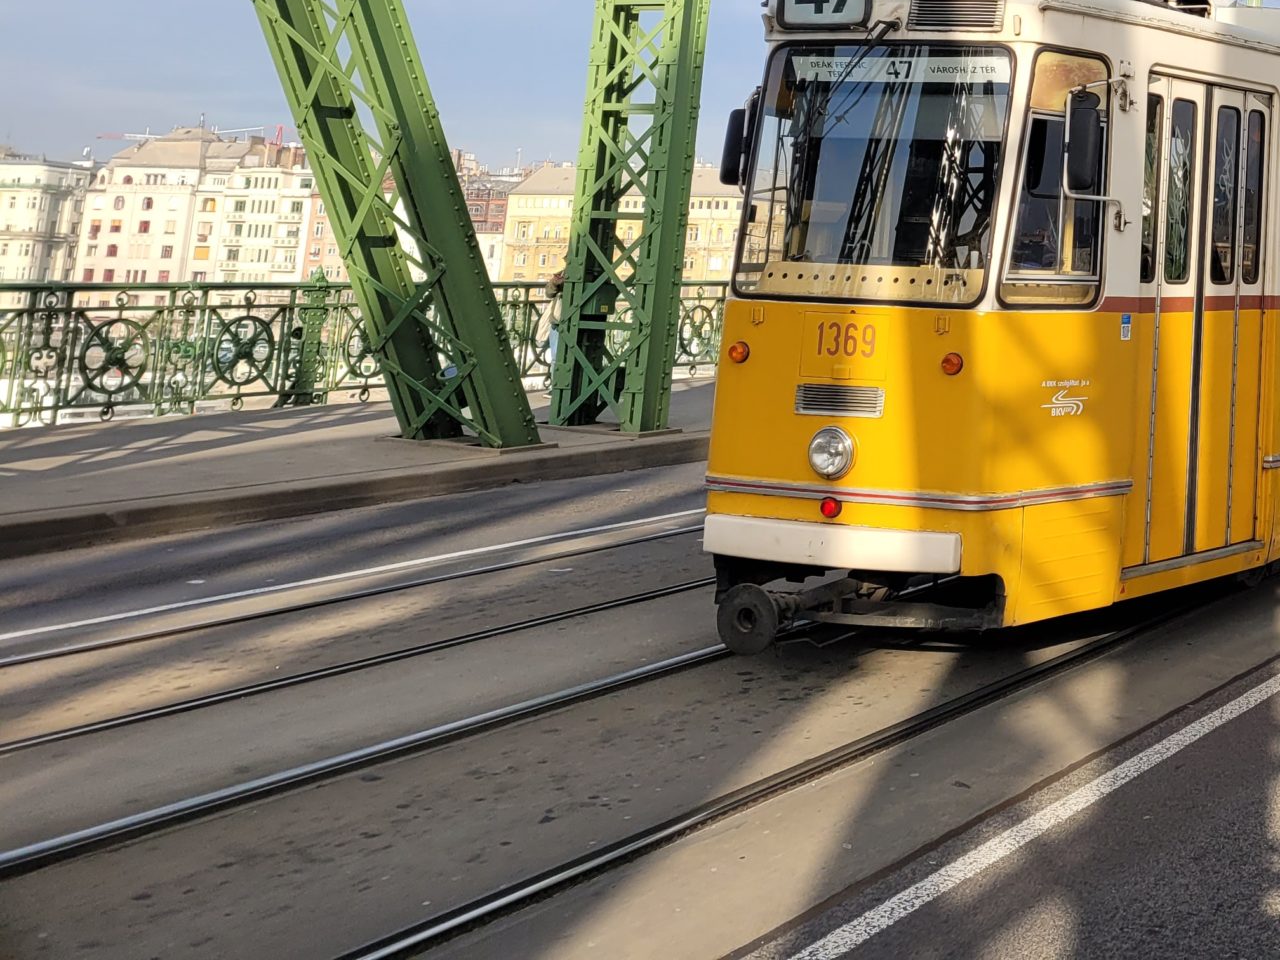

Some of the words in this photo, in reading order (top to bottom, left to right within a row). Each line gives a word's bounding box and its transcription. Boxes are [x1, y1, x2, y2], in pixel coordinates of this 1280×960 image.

[811, 59, 833, 69] DEÁK
[886, 60, 912, 79] 47
[929, 63, 978, 74] VÁROSHZ
[980, 63, 997, 74] TÉR
[816, 321, 876, 358] 1369
[1051, 407, 1065, 416] BKV
